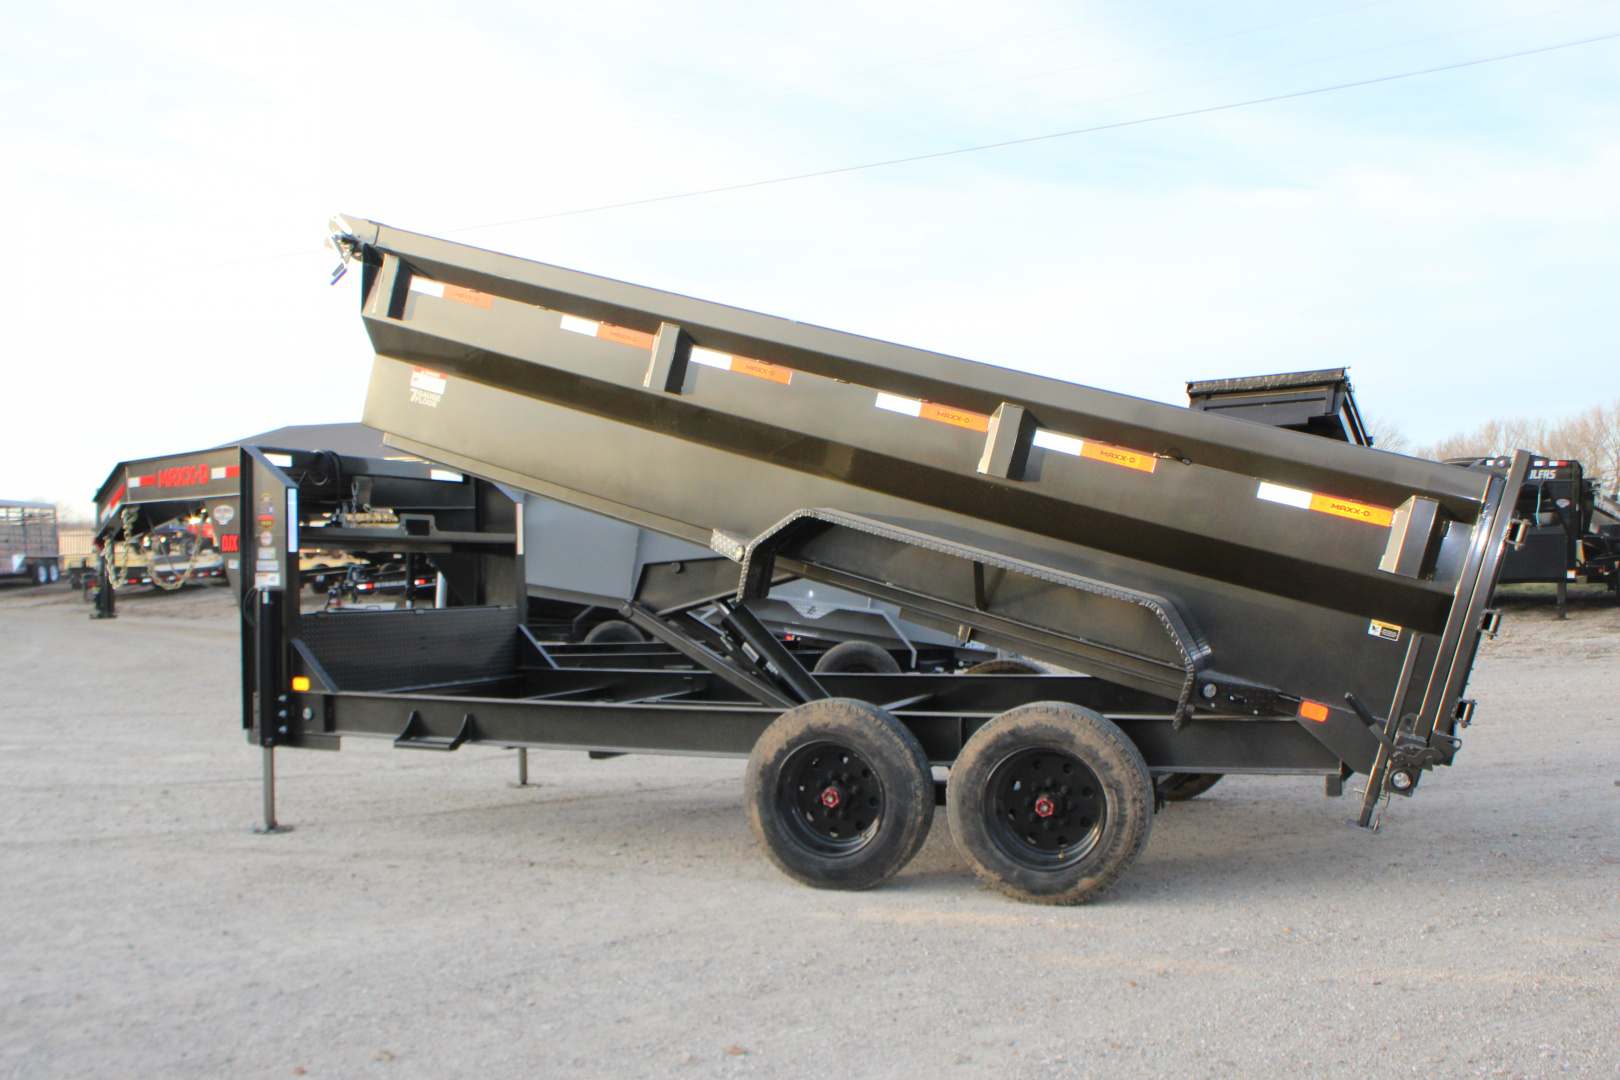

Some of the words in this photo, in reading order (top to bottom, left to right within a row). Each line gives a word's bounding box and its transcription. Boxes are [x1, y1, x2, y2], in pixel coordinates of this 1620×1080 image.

[745, 364, 775, 377] MAXX-D
[414, 397, 438, 409] FLOOR
[936, 411, 970, 424] MAXX-D
[1099, 450, 1136, 464] MAXX-D
[157, 463, 210, 489] MAXX-D
[1331, 503, 1371, 517] MAXX-D
